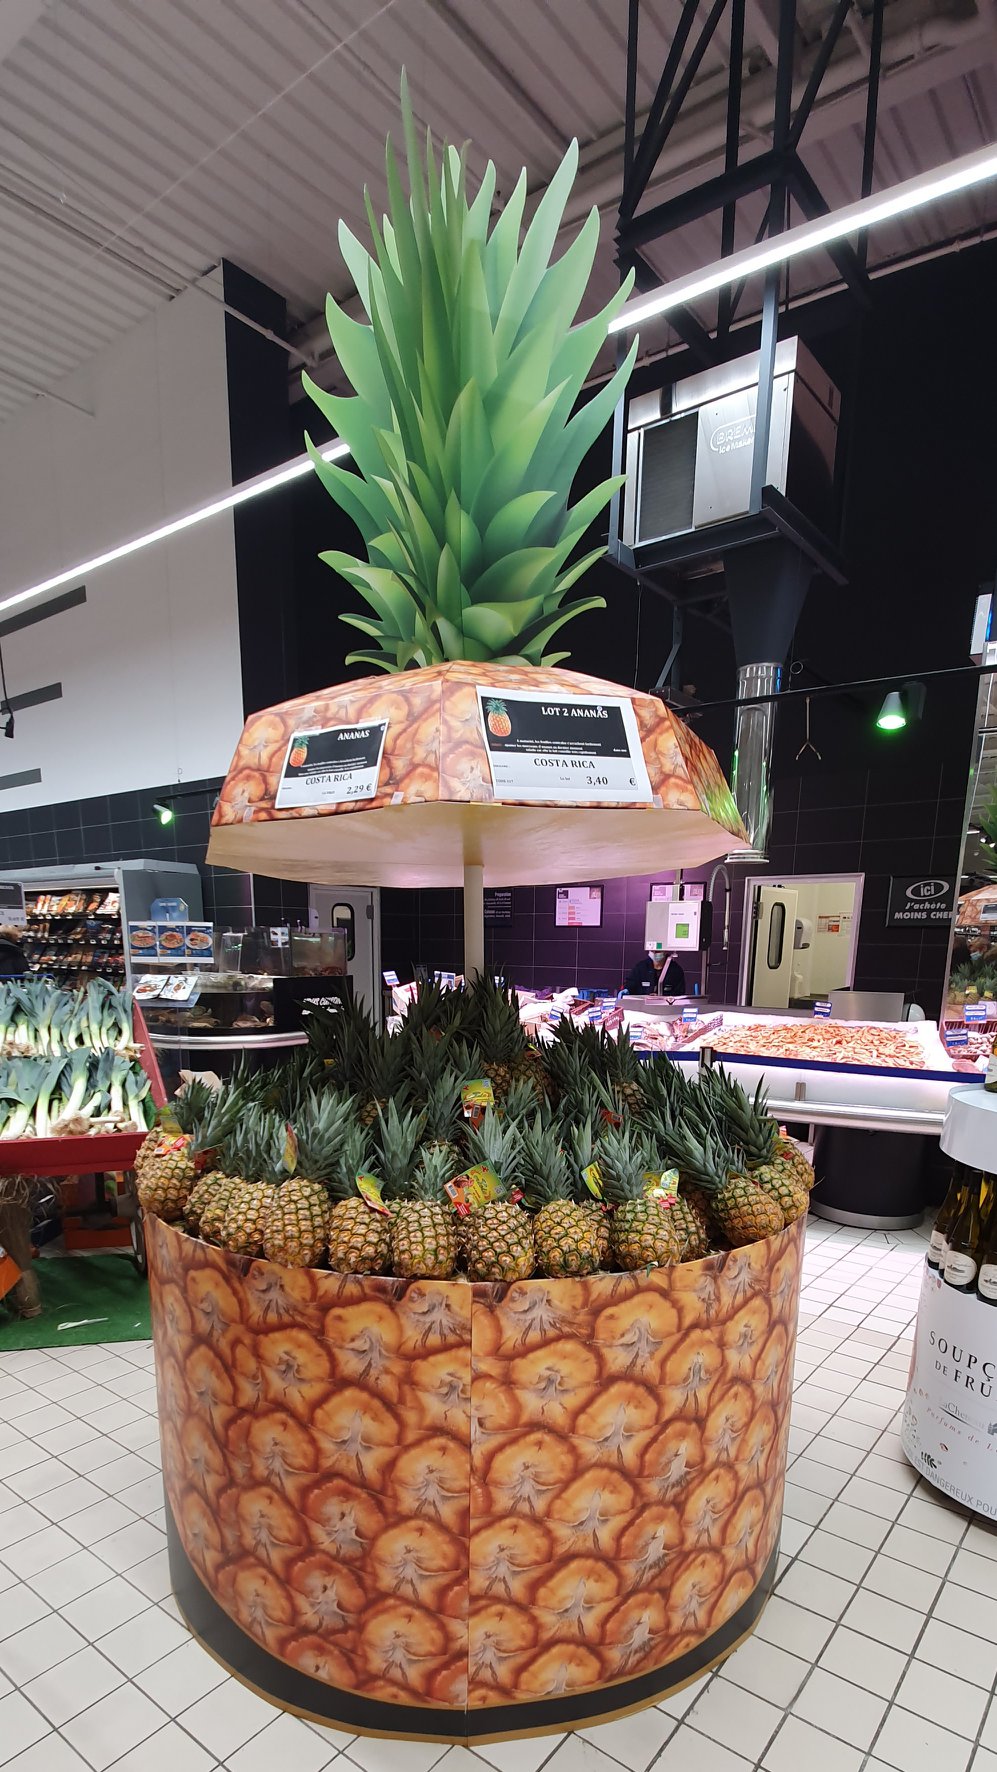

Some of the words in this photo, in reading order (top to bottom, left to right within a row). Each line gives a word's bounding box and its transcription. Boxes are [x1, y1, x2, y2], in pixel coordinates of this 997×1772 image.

[541, 706, 561, 717] LOT
[562, 708, 569, 717] 2
[571, 708, 608, 719] ANANAS
[337, 730, 370, 740] ANANAS
[533, 758, 569, 768] COSTA
[571, 759, 596, 769] RICA
[305, 774, 331, 786] COSTA
[333, 772, 353, 783] RICA
[586, 776, 609, 787] 3,40
[629, 777, 637, 787] €
[346, 784, 364, 796] 2,29
[366, 783, 373, 792] €
[920, 882, 935, 897] ici
[894, 911, 928, 920] MOINS
[929, 1330, 996, 1382] SOUPÇ
[934, 1360, 948, 1376] DE
[925, 1466, 974, 1505] DANGEREUX
